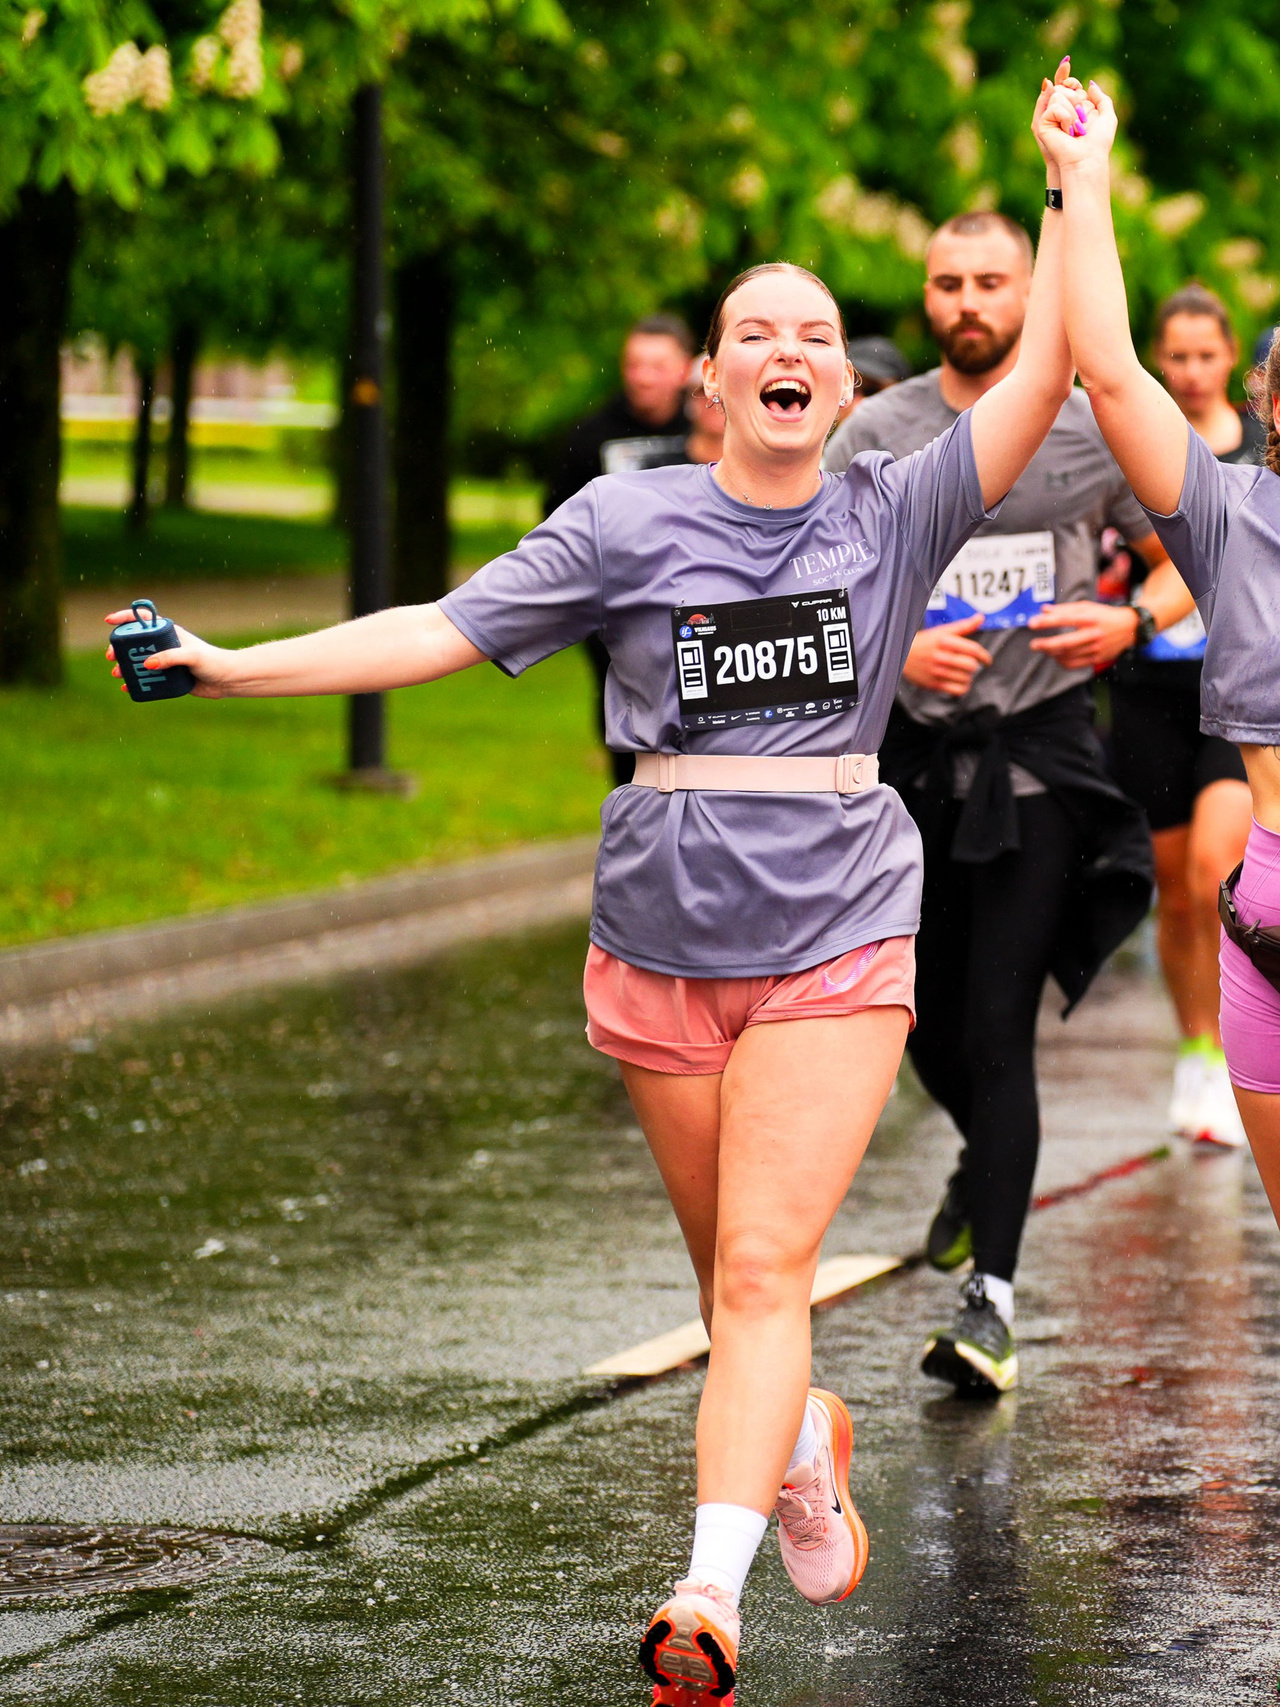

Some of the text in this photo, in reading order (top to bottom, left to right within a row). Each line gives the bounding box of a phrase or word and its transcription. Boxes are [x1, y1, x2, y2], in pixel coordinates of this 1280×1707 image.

[788, 539, 875, 579] TEMPLE
[813, 570, 841, 586] SOCIAL
[954, 567, 1026, 598] 11247
[816, 606, 847, 622] 10 KM
[713, 635, 818, 685] 20875
